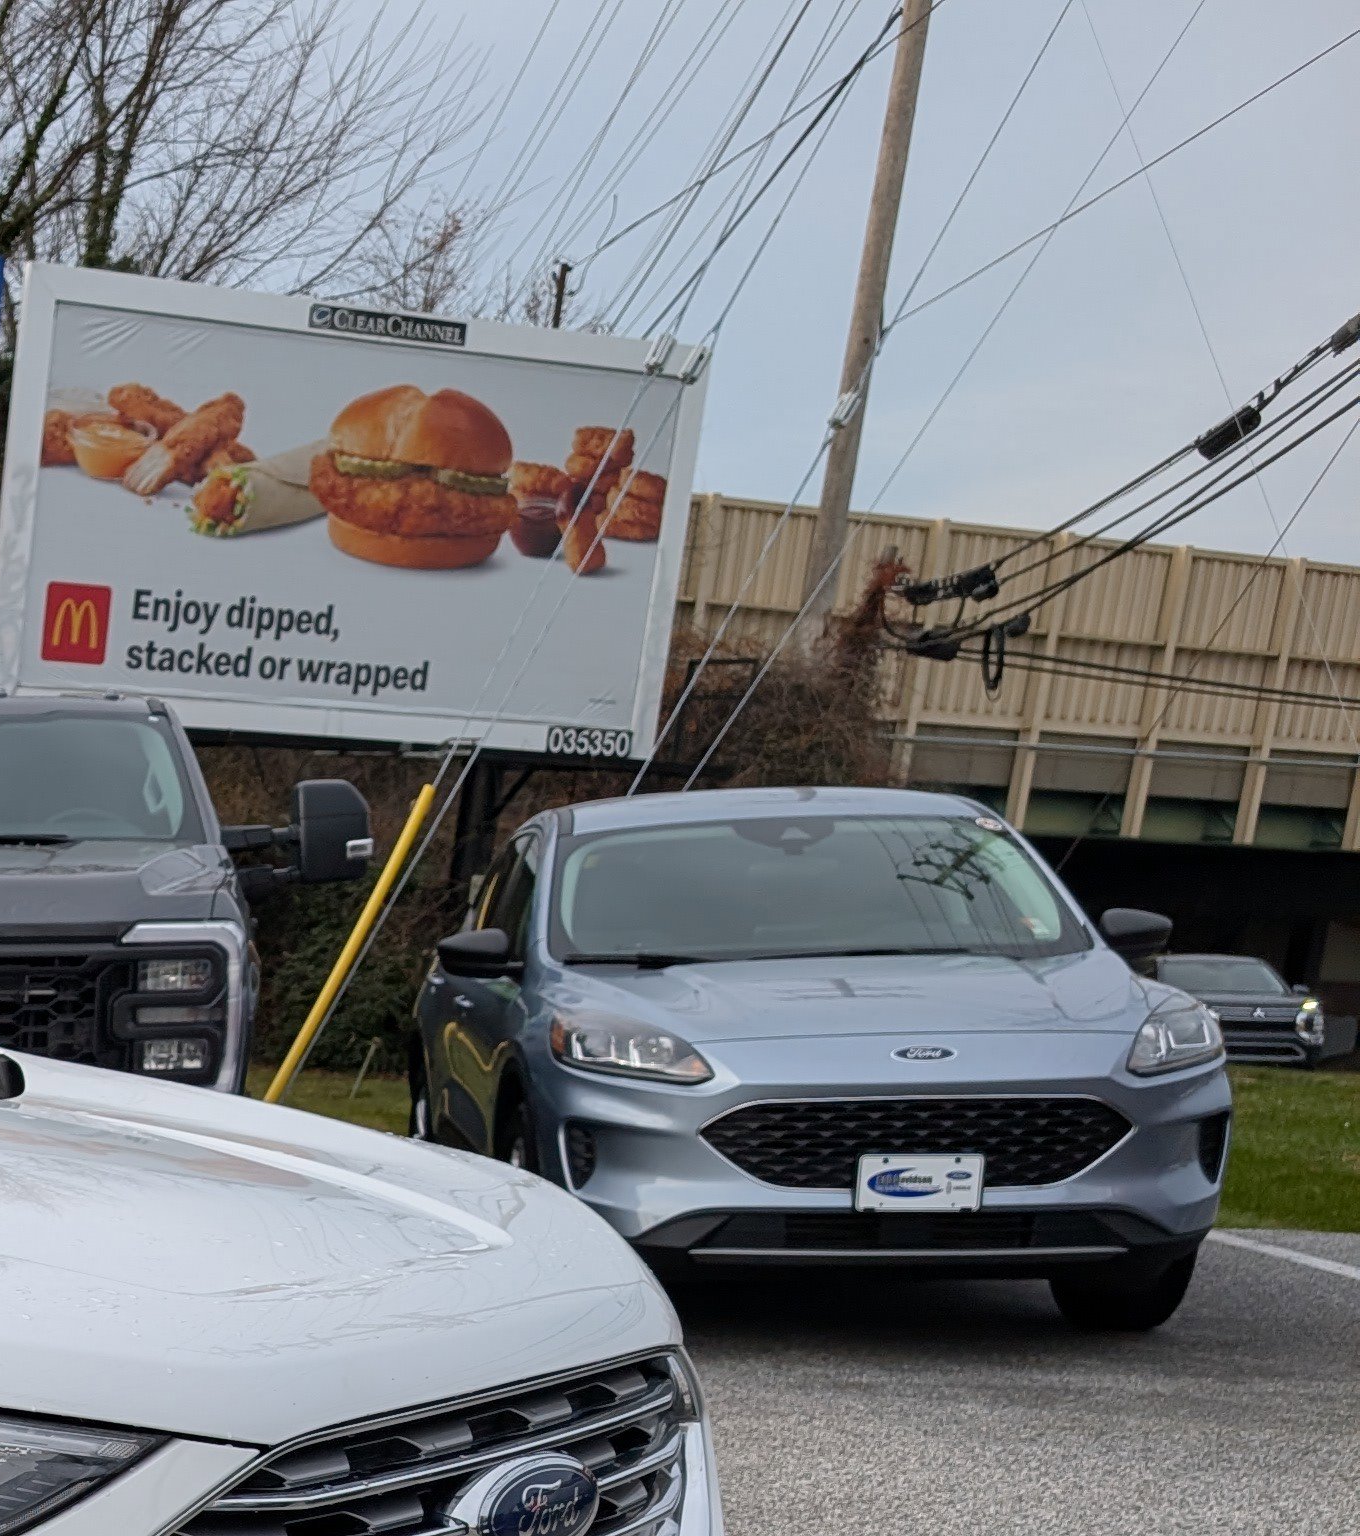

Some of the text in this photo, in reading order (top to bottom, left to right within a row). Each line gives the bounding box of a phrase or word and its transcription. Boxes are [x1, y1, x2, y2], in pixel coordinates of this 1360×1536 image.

[131, 588, 341, 642] Enjoy dipped,
[125, 640, 430, 698] stacked or wrapped
[905, 1046, 943, 1060] Ford
